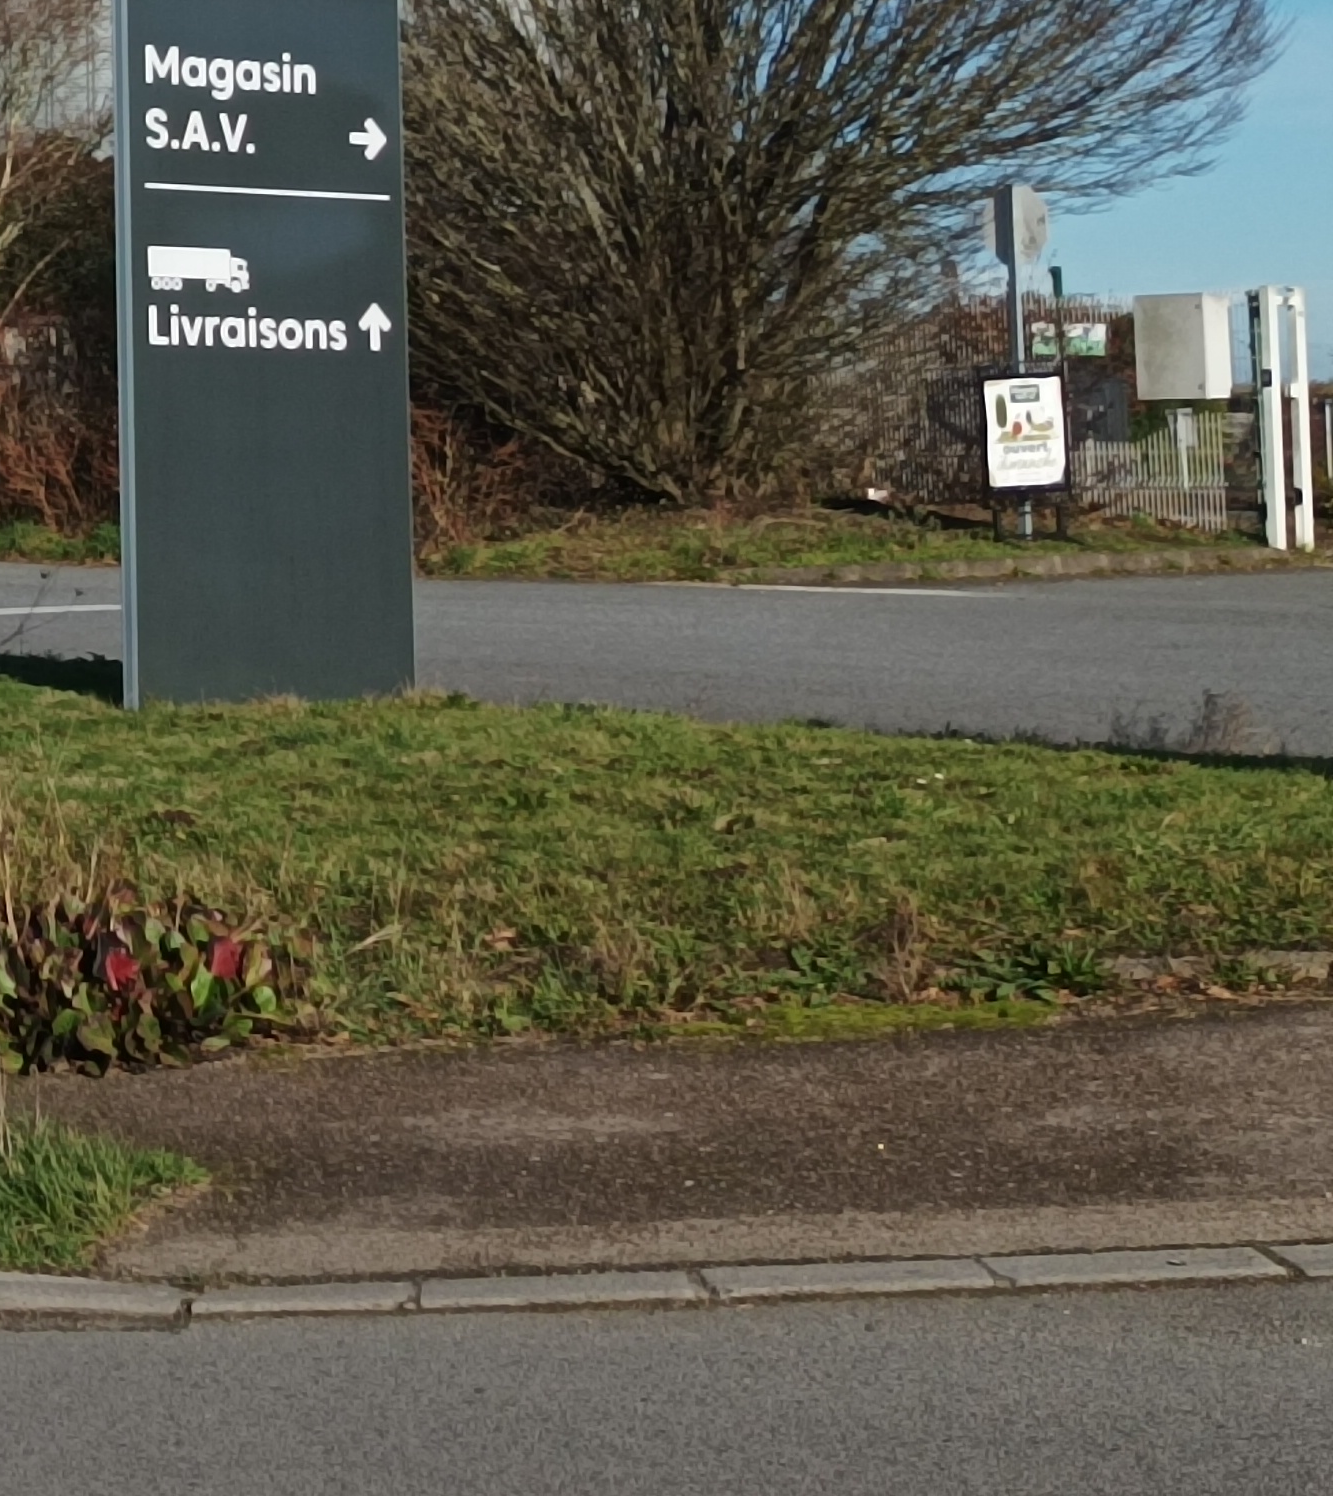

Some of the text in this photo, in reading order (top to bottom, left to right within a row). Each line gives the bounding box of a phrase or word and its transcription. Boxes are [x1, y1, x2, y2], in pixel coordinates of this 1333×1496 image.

[144, 44, 317, 101] Magasin
[145, 107, 256, 154] S.A.V.
[147, 304, 348, 351] Livraisons
